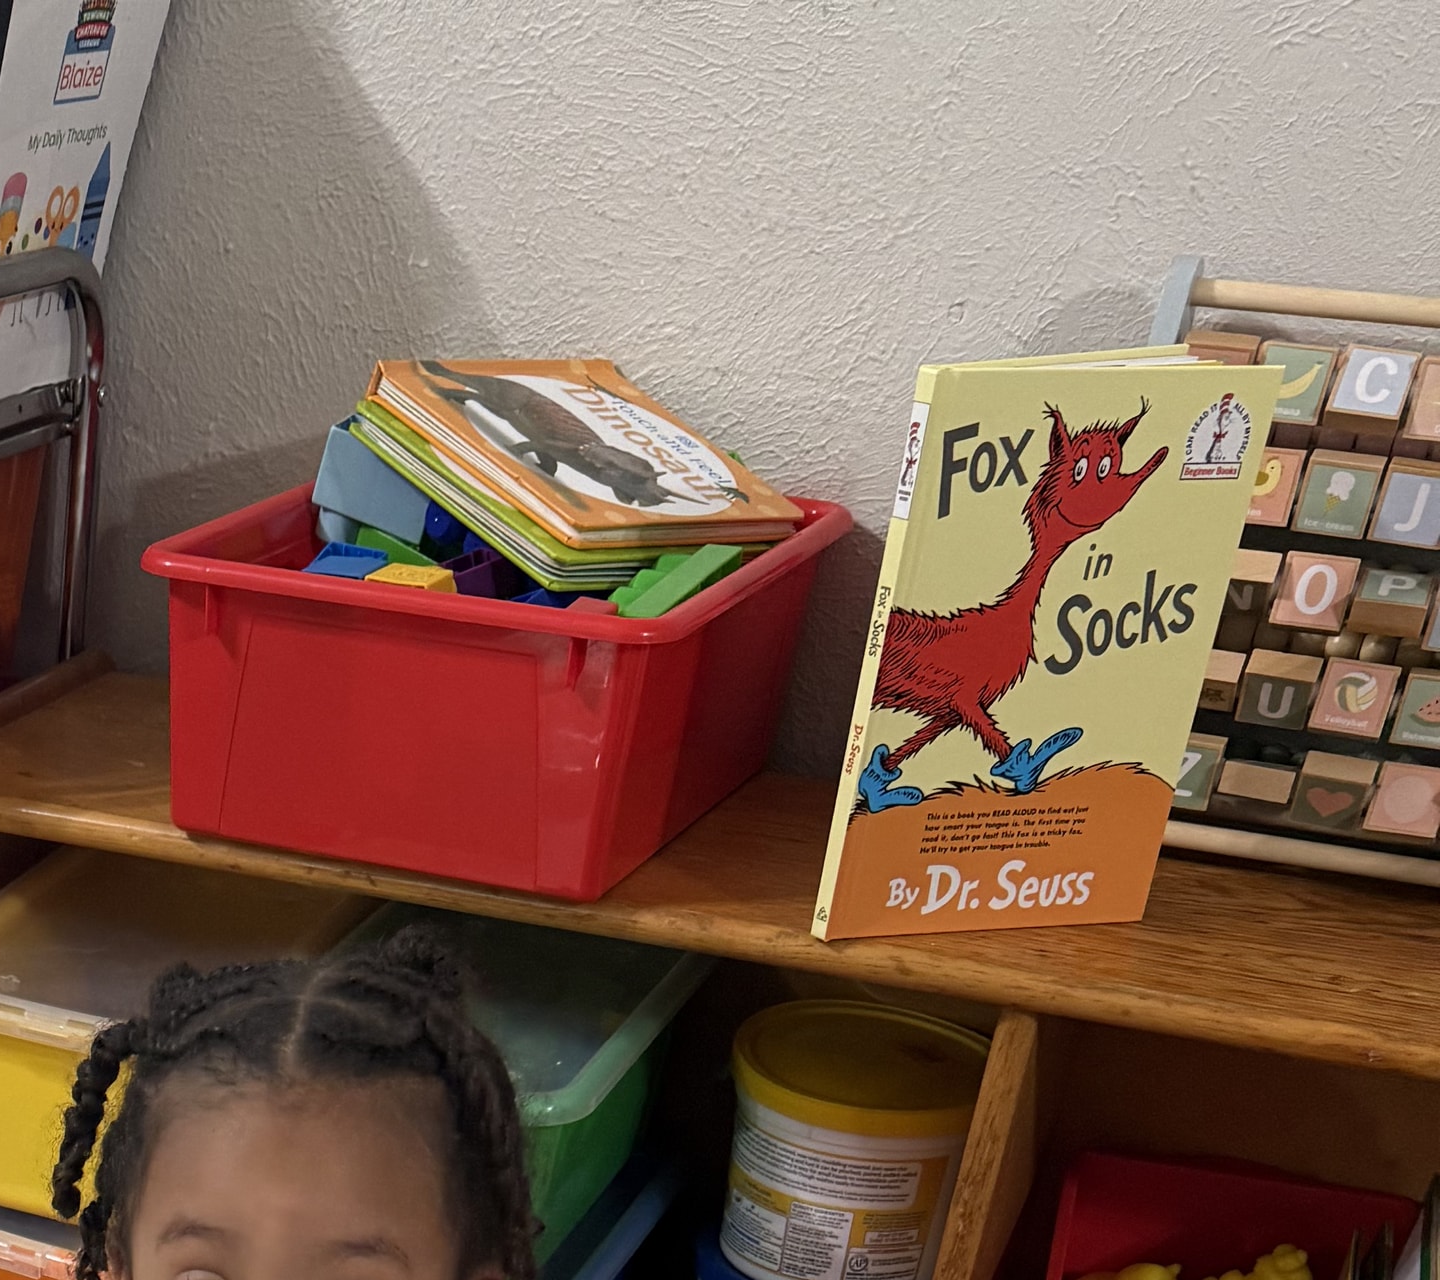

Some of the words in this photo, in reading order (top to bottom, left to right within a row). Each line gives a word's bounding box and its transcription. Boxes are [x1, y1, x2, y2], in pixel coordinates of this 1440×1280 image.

[60, 60, 103, 90] Blaize
[28, 134, 41, 154] My
[42, 129, 66, 152] Daily
[66, 124, 107, 146] Thoughts
[1355, 356, 1398, 404] C
[562, 388, 732, 500] Dinosaur
[1186, 436, 1194, 455] CAN
[1191, 411, 1209, 433] READ
[1211, 403, 1218, 413] IT
[1242, 413, 1250, 424] BY
[938, 422, 1035, 520] Fox
[1184, 467, 1215, 476] Beginner
[1216, 466, 1237, 475] Books
[1393, 483, 1431, 532] J
[1083, 543, 1114, 581] in
[878, 586, 891, 609] Fox
[1294, 563, 1338, 616] O
[1378, 574, 1418, 597] P
[869, 620, 885, 657] Socks
[1044, 569, 1198, 676] Socks
[1257, 682, 1296, 720] U
[853, 724, 864, 742] Dr.
[846, 743, 860, 775] Seuss
[885, 876, 920, 911] By
[921, 864, 980, 915] Dr.
[987, 859, 1095, 911] Seuss
